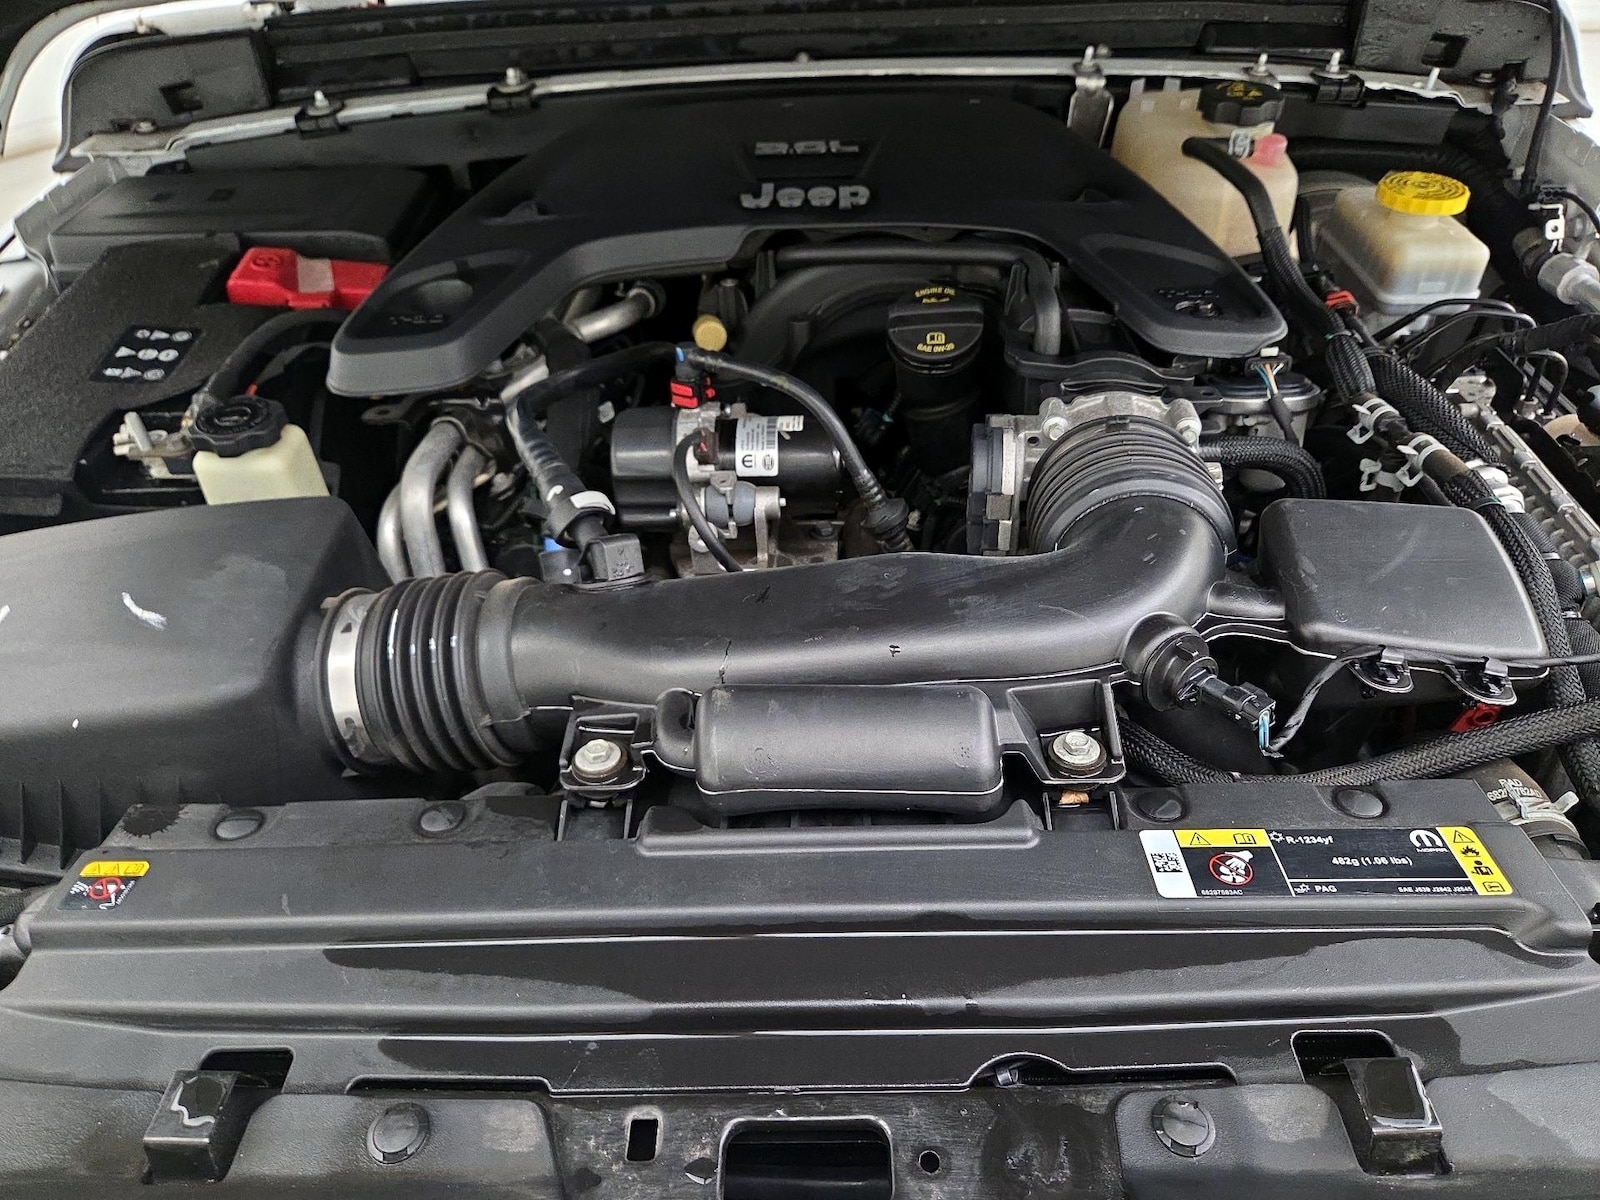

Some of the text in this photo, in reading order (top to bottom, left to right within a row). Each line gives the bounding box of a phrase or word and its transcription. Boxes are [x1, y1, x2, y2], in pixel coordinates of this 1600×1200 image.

[740, 183, 870, 209] Jeep
[914, 286, 956, 297] ENGINE OIL
[917, 342, 955, 352] SAE 0W-20
[1285, 835, 1334, 845] R-1234yf
[1390, 856, 1413, 867] lbs)
[1314, 884, 1338, 893] PAG
